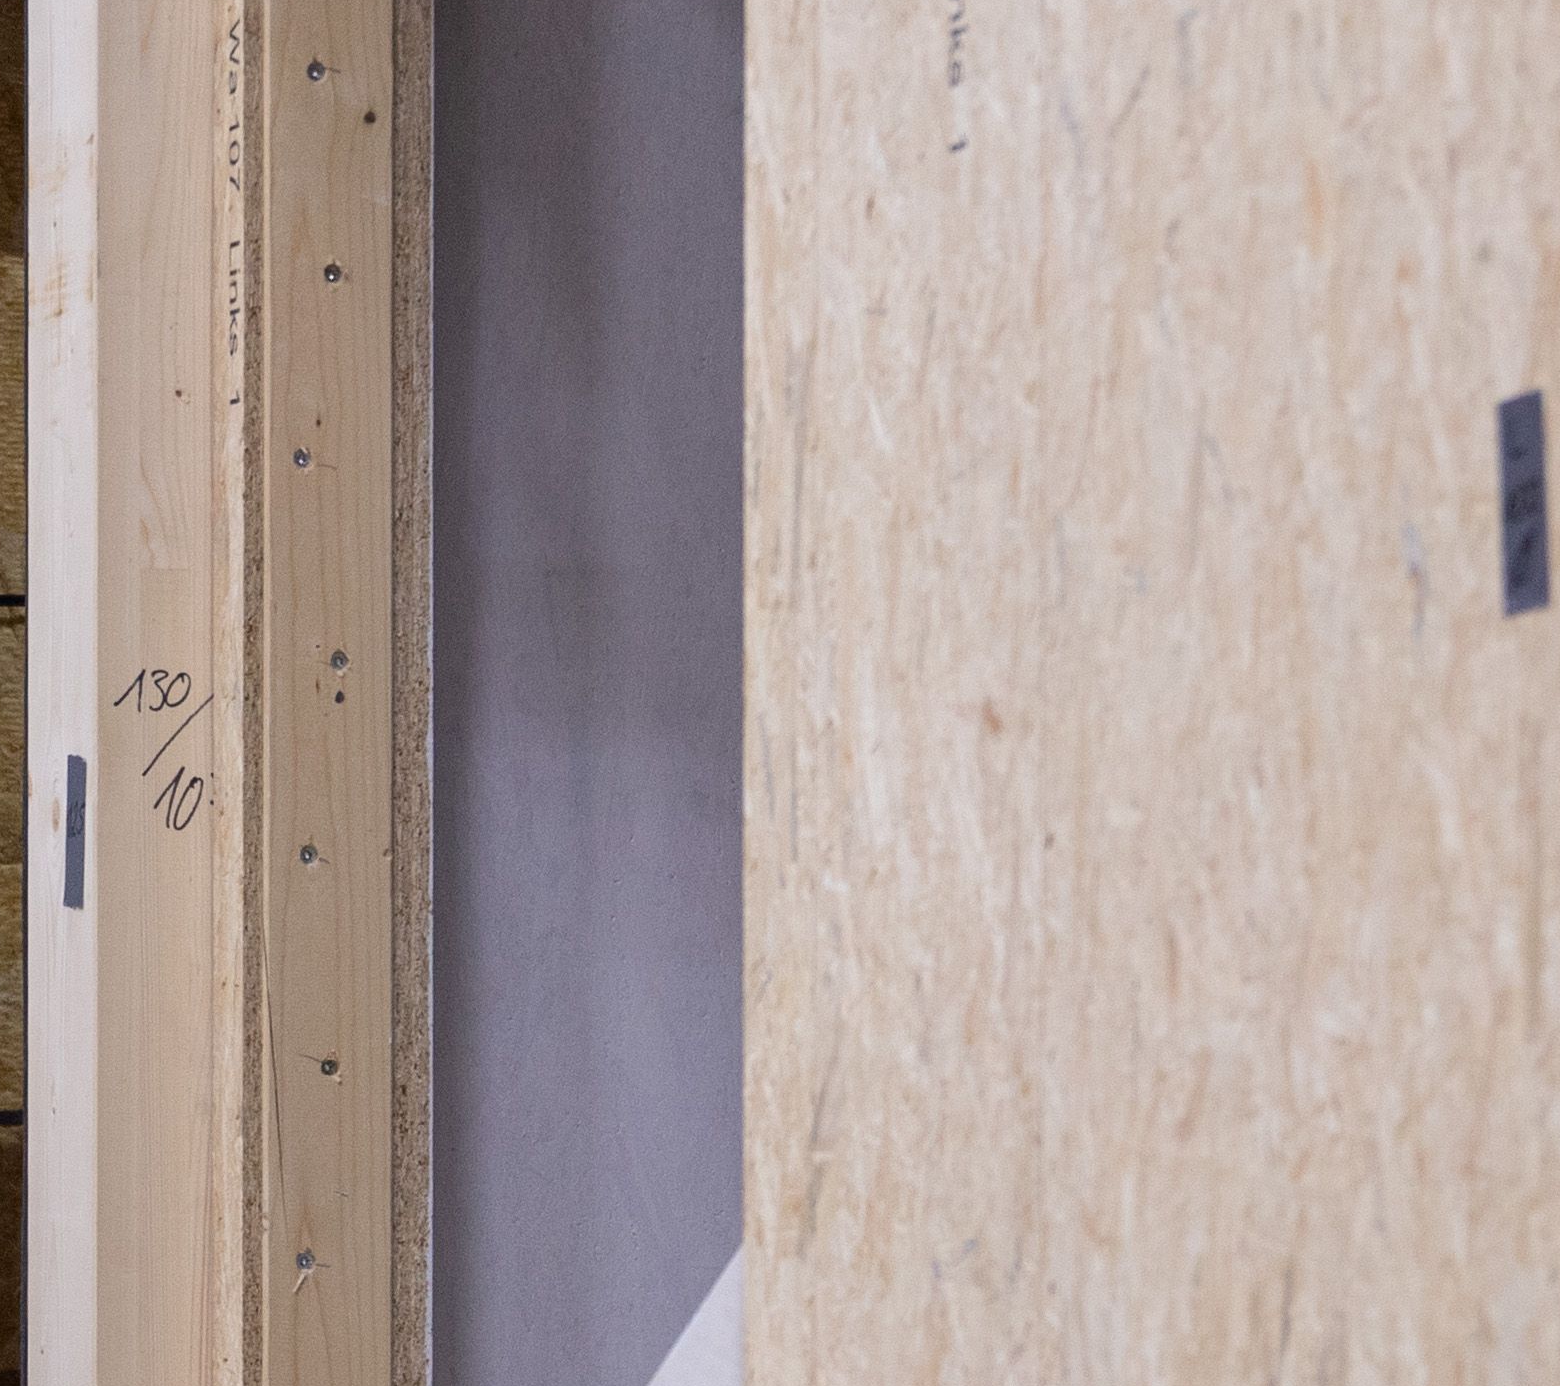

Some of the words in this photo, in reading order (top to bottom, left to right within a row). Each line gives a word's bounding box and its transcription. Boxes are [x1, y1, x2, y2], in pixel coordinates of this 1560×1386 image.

[229, 16, 242, 95] Wa
[229, 113, 242, 192] 107
[229, 239, 242, 357] Links
